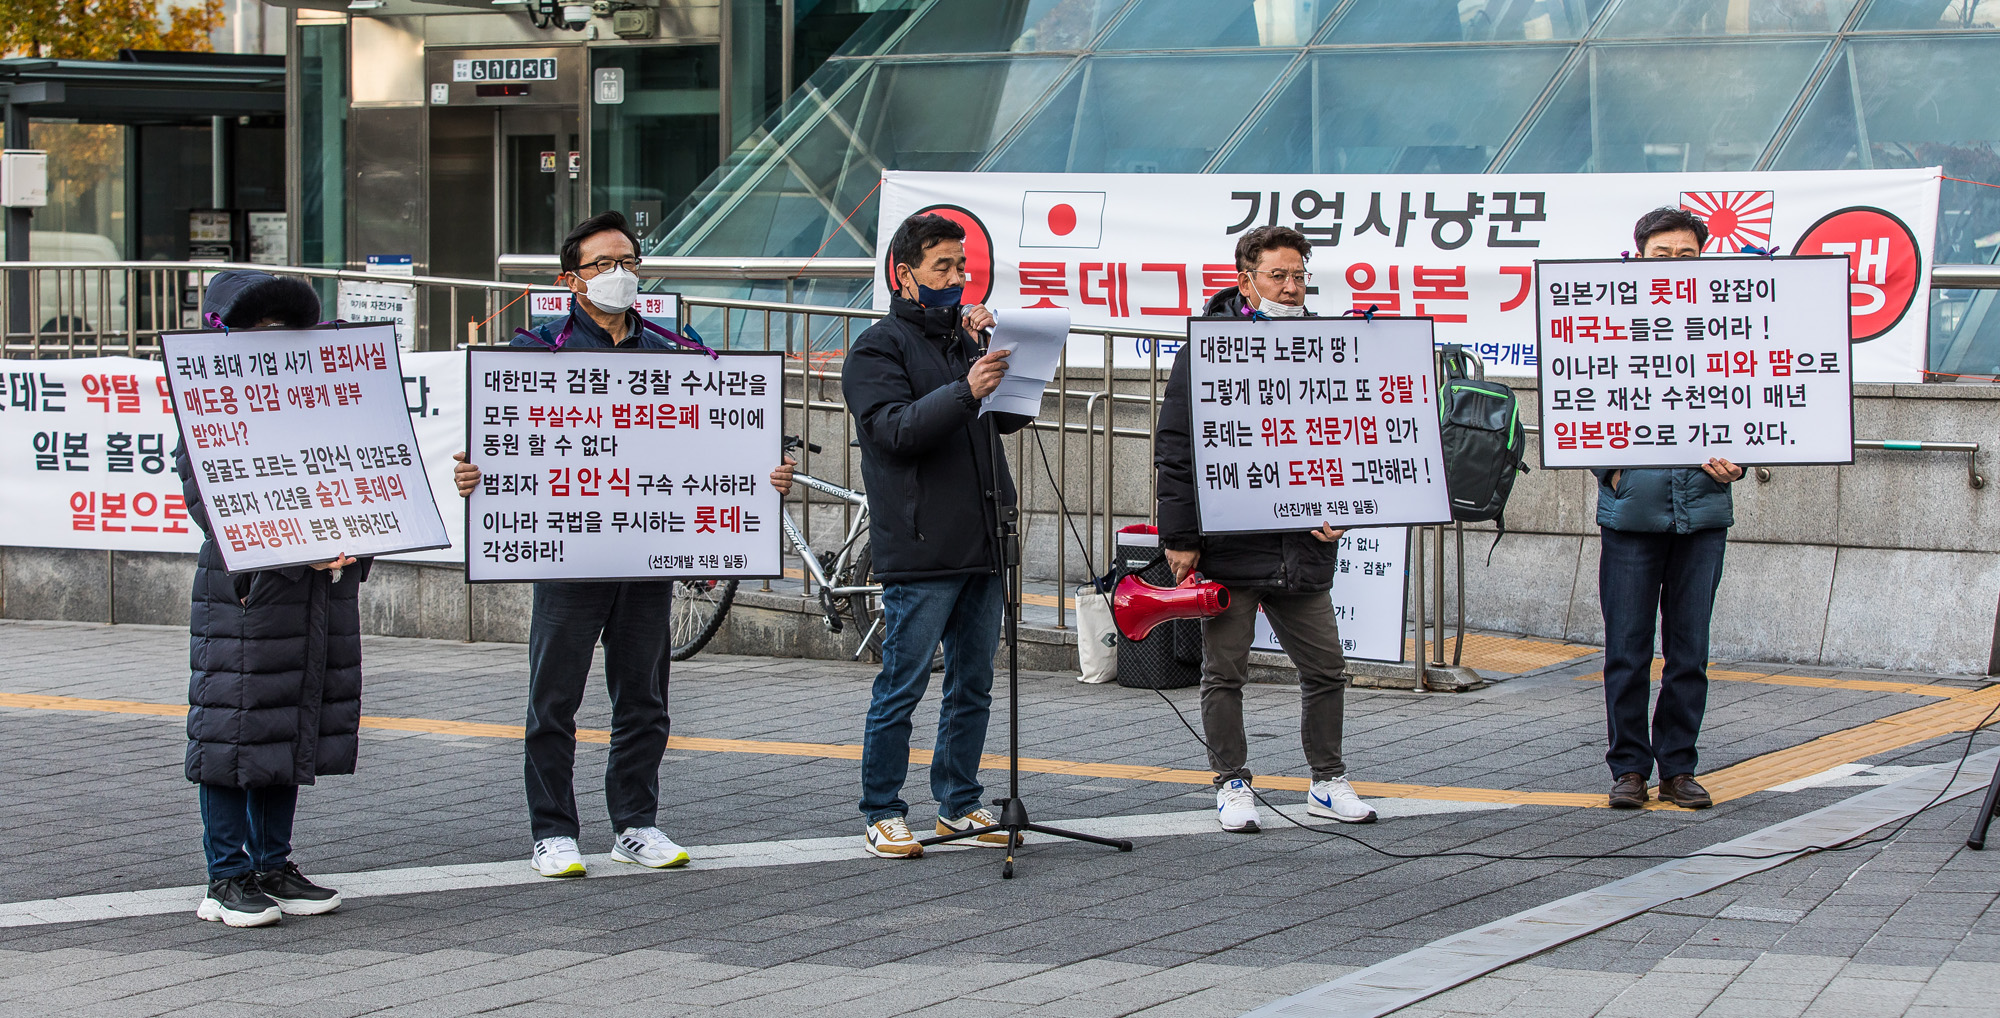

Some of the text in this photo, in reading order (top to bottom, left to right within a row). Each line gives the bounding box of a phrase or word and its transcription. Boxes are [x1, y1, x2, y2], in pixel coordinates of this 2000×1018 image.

[1225, 189, 1546, 250] 기업사냥꾼
[370, 301, 403, 312] 자전거를
[1345, 263, 1469, 323] 일본
[1549, 279, 1639, 306] 일본기업
[1649, 277, 1698, 306] 롯데
[1709, 277, 1776, 303] 앞잡이
[1551, 315, 1674, 344] 매국노들은
[1684, 315, 1752, 341] 들어라
[176, 342, 388, 380] 국내 최대 기업 사기 범죄사실
[1200, 336, 1267, 364] 대한민국
[1273, 336, 1324, 364] 노른자
[1330, 336, 1347, 363] 땅
[1552, 348, 1841, 380] 이나라 국민이 피와 땀으로
[0, 372, 67, 413] 데는
[81, 373, 141, 414] 약탈
[484, 369, 558, 394] 대한민국
[680, 368, 768, 397] 수사관을
[1200, 378, 1251, 406] 그렇게
[1258, 378, 1292, 406] 많이
[1299, 377, 1349, 405] 가지고
[1355, 378, 1372, 402] 또
[1378, 375, 1414, 404] 강탈
[1552, 383, 1807, 412] 모은 재산 수천억이 매년
[183, 384, 238, 417] 매도용
[244, 383, 281, 413] 인감
[286, 384, 331, 409] 어떻게
[333, 382, 363, 406] 발부
[483, 403, 765, 430] 모두 부실수사 범죄은폐 막이에
[191, 420, 250, 450] 받았나?
[483, 433, 619, 457] 동원 할 수 없다
[1202, 415, 1419, 449] 롯데는 위조 전문기업 인가
[1553, 420, 1796, 450] 일본땅으로 가고 있다.
[32, 431, 179, 475] 일본 홀딩
[201, 443, 413, 484] 얼굴도 모르는 김안식 인감도용
[483, 473, 539, 497] 범죄자
[636, 473, 674, 497] 구속
[681, 473, 757, 497] 수사하라
[1205, 462, 1240, 490] 뒤에
[1246, 461, 1281, 489] 숨어
[1288, 457, 1345, 488] 도적질
[1351, 457, 1418, 486] 그만해라
[211, 473, 408, 518] 범죄자 12년을 숨긴 롯데의
[1273, 498, 1379, 519] (선진개발 직원 일동)
[70, 491, 190, 534] 일본으로
[483, 505, 761, 534] 이나라 국법을 무시하는 롯데는
[223, 510, 402, 553] 범죄행위! 분명 밝혀진다
[1357, 537, 1380, 553] 없나
[483, 539, 565, 564] 각성하라!
[647, 552, 749, 571] (선진개발 직원 일동)
